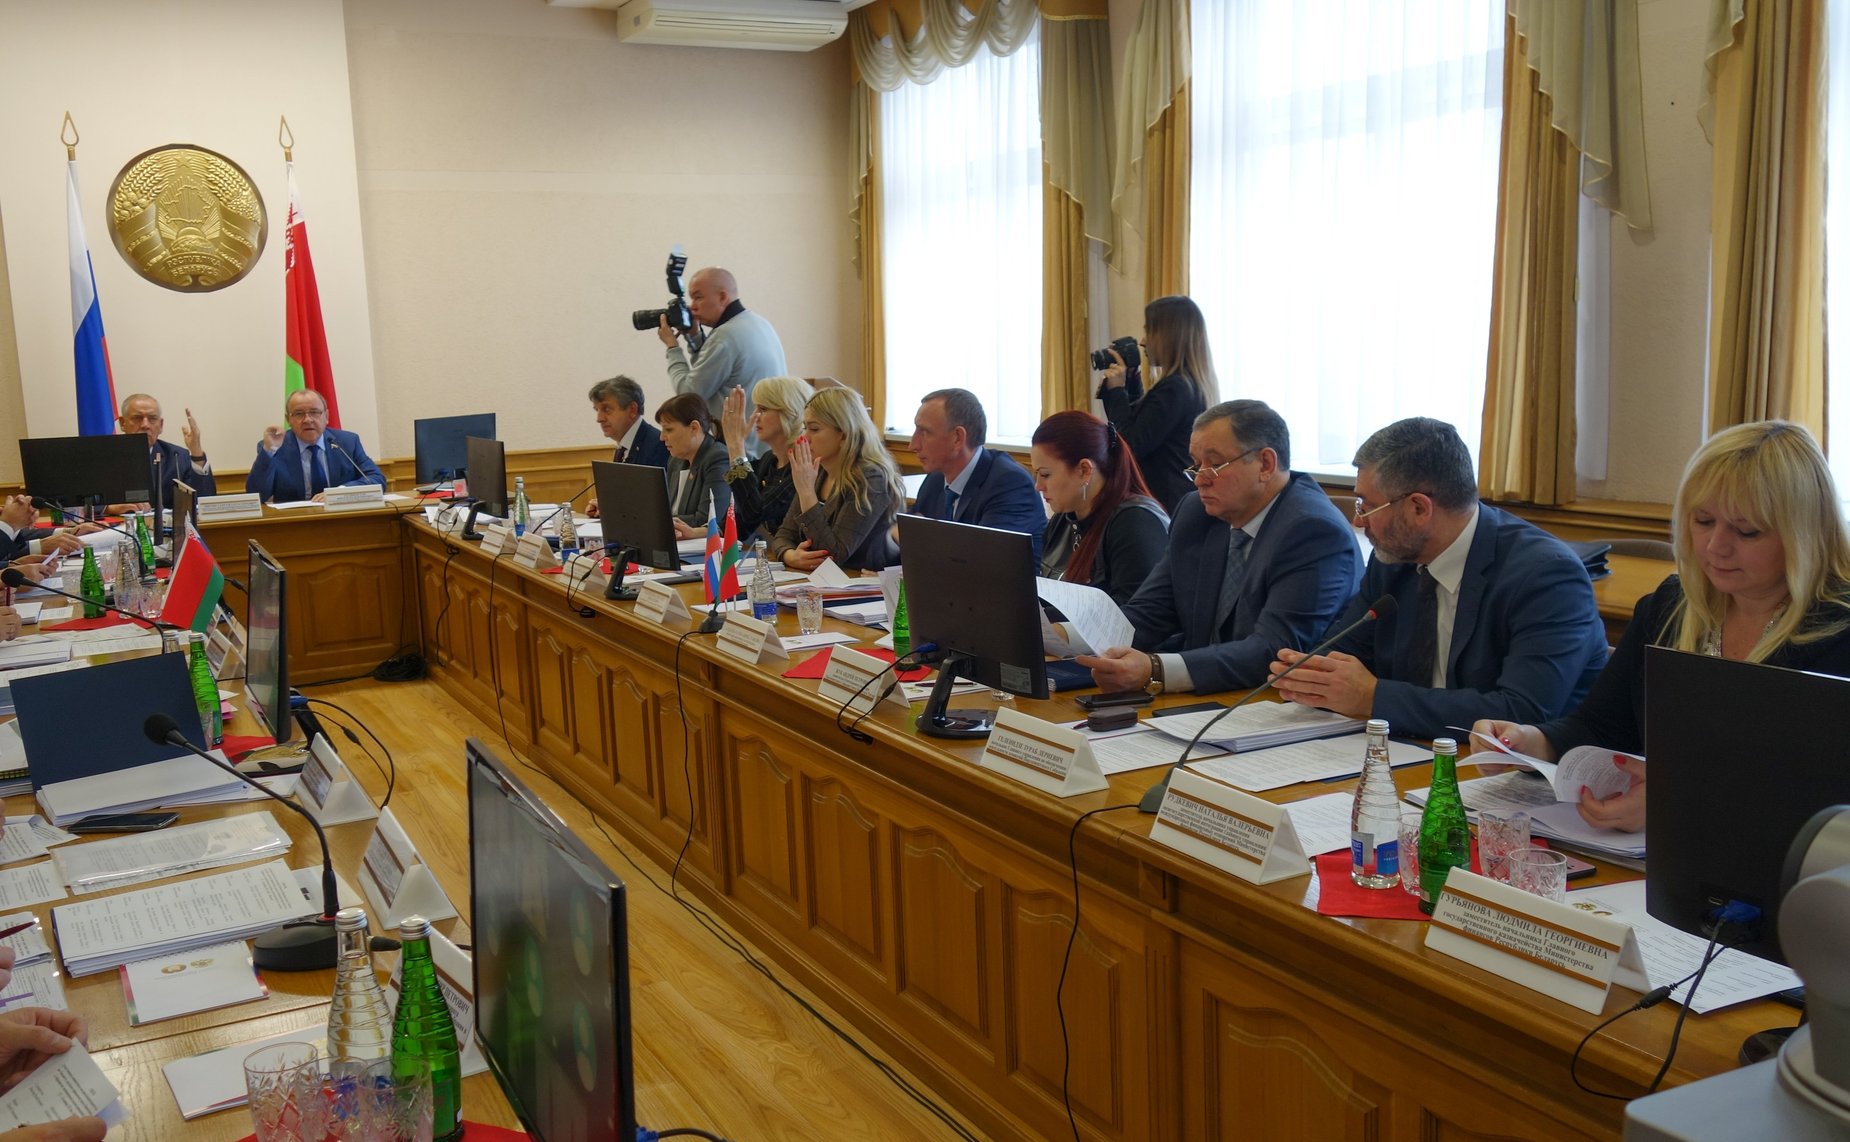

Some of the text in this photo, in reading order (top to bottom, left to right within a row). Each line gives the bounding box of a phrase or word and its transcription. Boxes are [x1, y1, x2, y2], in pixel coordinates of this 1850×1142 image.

[1198, 804, 1228, 823] НАТАЛЬЯ
[1227, 816, 1270, 840] ВАЛЕРЬЕВНА
[1440, 892, 1609, 960] ГУРЬЯНОВА ЛЮДМИЛА ГЕОРГИЕВНА
[1442, 910, 1594, 972] государственного казначейства Министерства
[1463, 910, 1576, 956] заместитель начальника Главного
